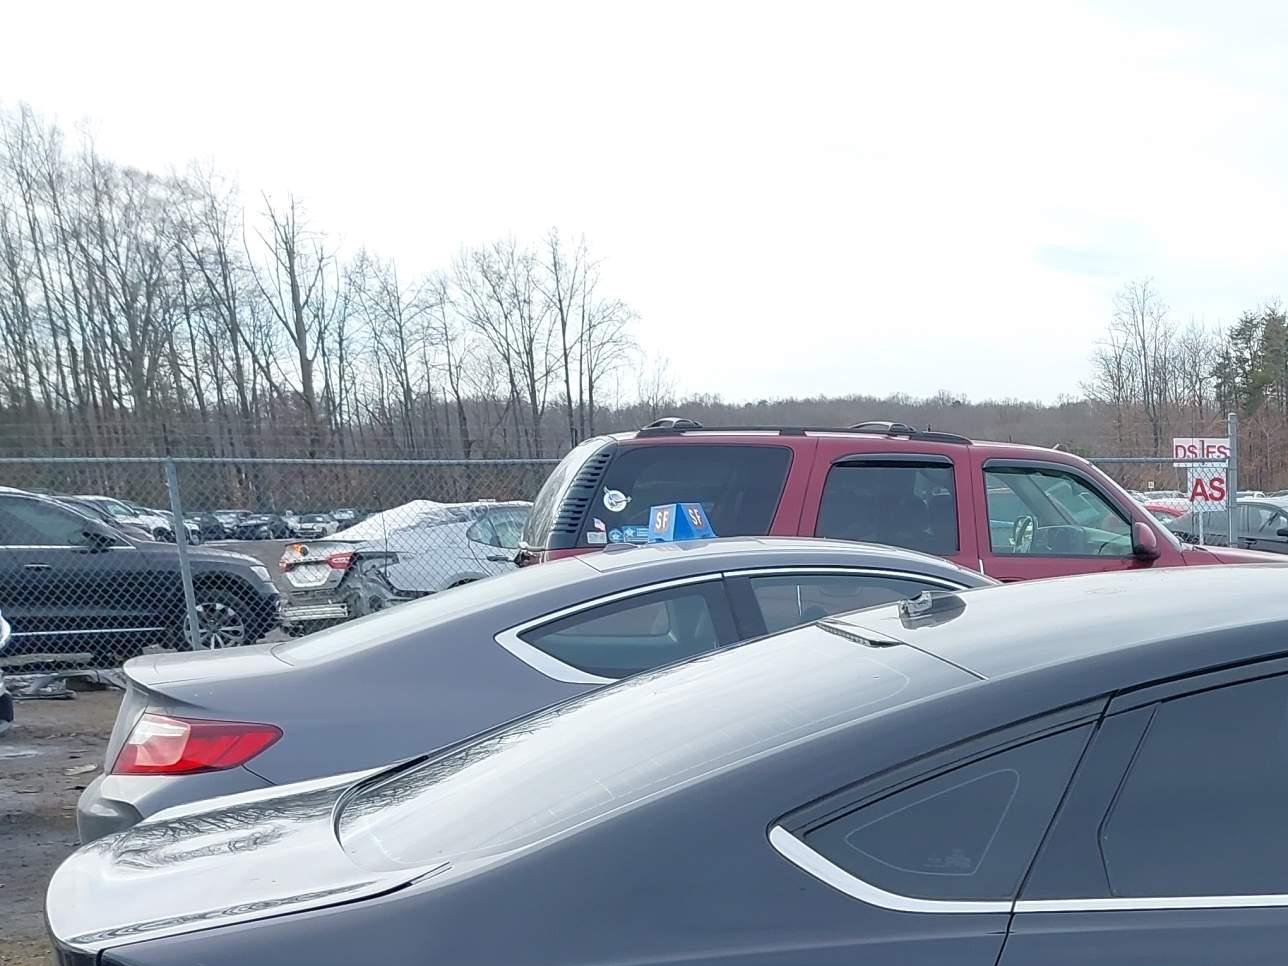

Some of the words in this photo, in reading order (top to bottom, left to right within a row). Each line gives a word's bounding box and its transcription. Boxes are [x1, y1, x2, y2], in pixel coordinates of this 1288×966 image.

[1175, 444, 1198, 459] DS
[1190, 477, 1225, 502] AS
[655, 511, 669, 529] SF
[688, 508, 702, 526] SF
